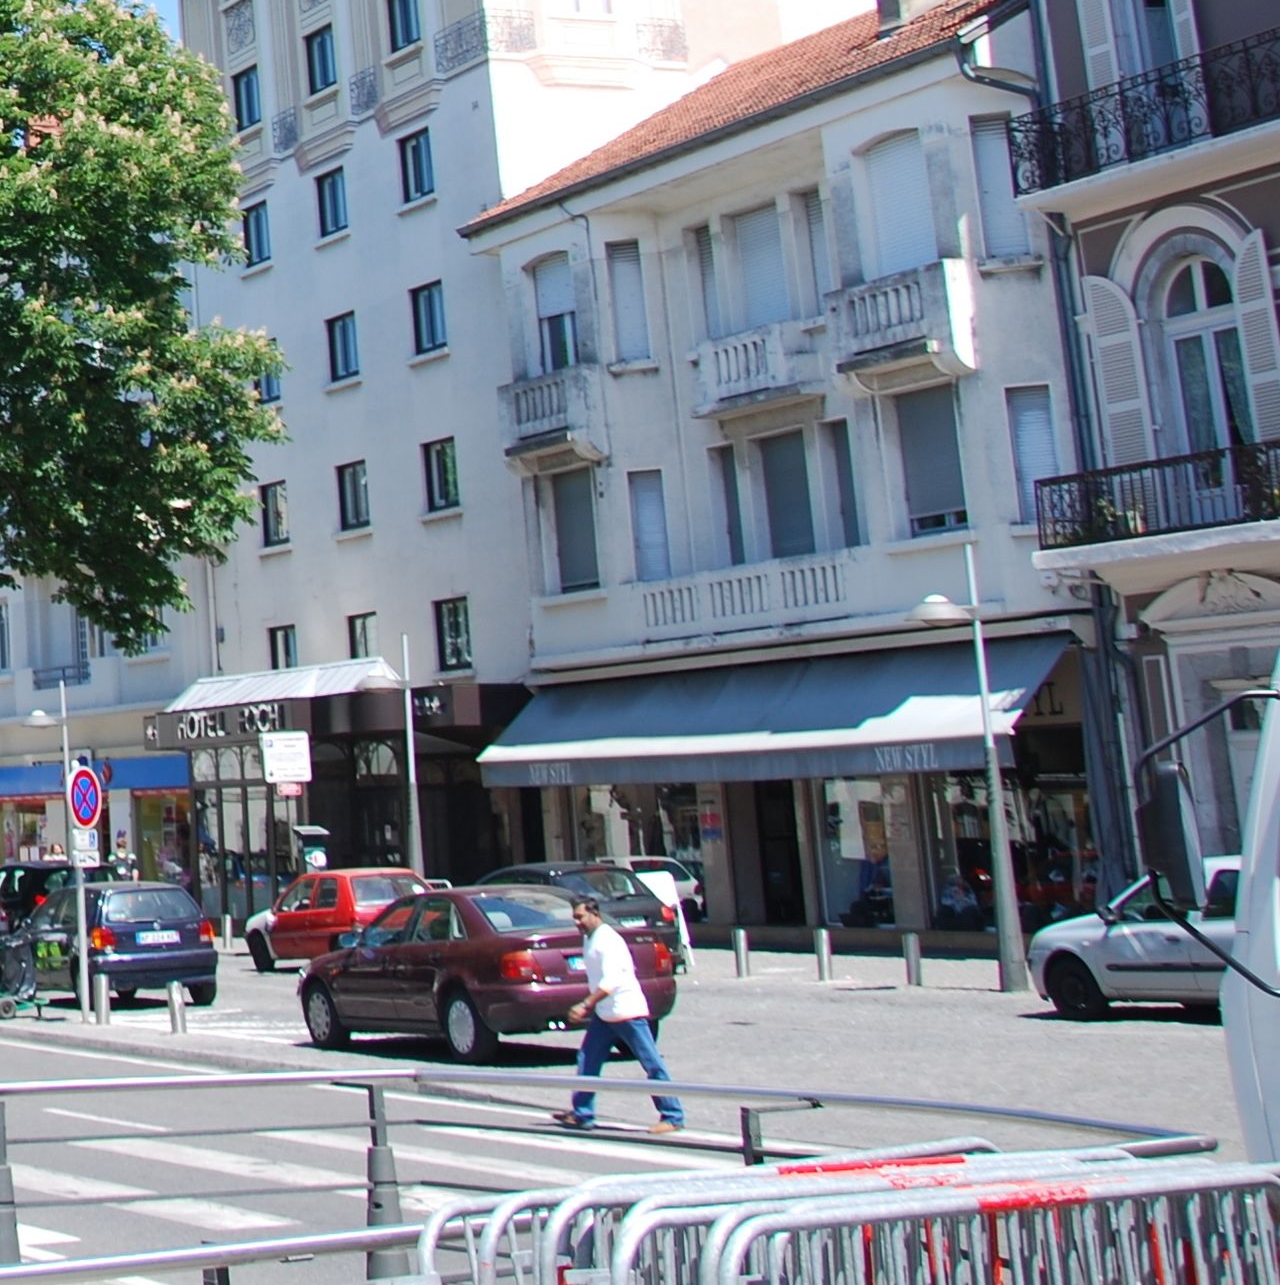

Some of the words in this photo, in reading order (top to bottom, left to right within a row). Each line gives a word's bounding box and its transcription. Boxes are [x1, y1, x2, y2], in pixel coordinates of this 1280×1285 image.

[177, 711, 228, 740] HOTEL
[874, 746, 903, 772] NEW
[904, 743, 939, 772] STYL
